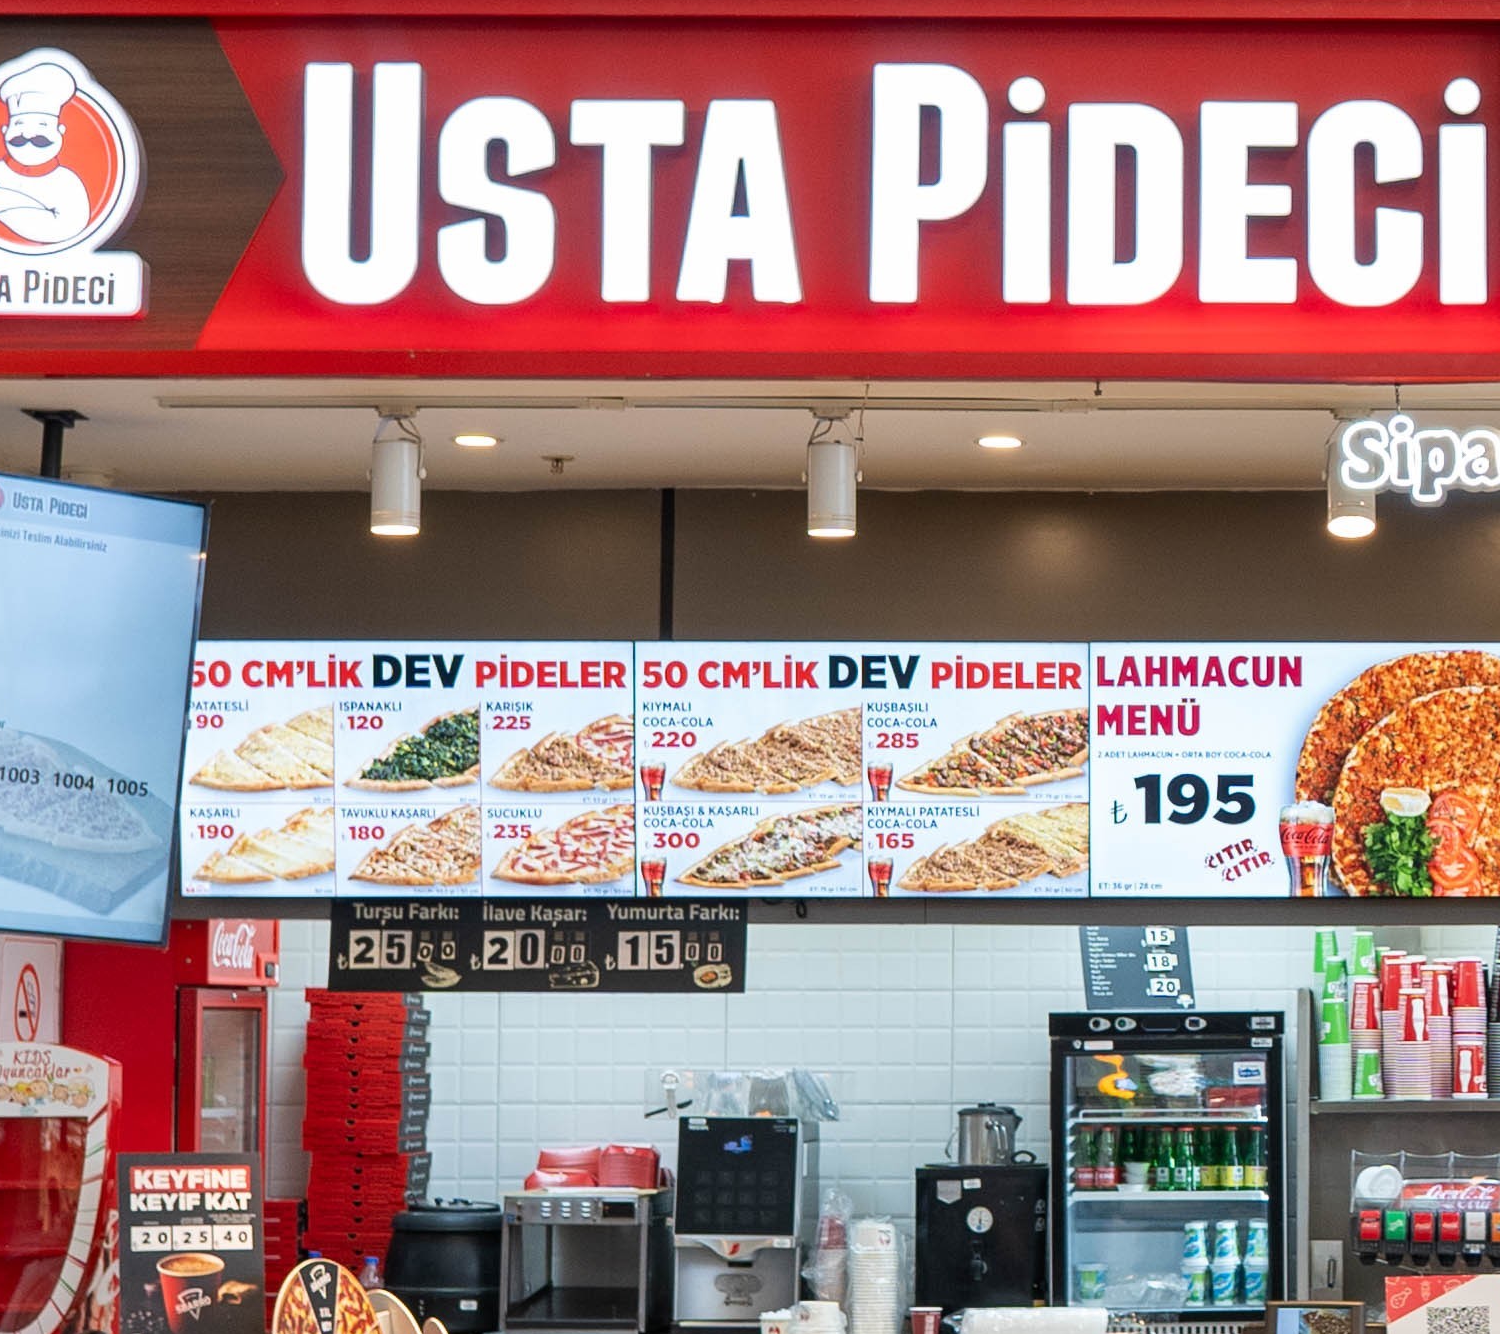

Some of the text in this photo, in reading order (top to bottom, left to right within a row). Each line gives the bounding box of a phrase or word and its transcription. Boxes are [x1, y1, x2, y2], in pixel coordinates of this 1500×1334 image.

[302, 61, 801, 307] USTA
[13, 491, 44, 515] USTA
[53, 533, 107, 553] Alabilirsiniz
[192, 660, 231, 688] 50
[373, 654, 464, 688] DEV
[476, 654, 626, 688] PİDELER
[642, 660, 688, 689] 50
[829, 655, 920, 689] DEV
[931, 654, 1082, 689] PİDELER
[1097, 655, 1303, 688] LAHMACUN
[339, 701, 402, 712] ISPANAKLI
[643, 701, 692, 712] KIYMALI
[196, 715, 223, 729] 90
[348, 715, 383, 730] 120
[492, 715, 531, 731] 225
[643, 717, 714, 728] COCA-COLA
[867, 717, 938, 728] COCA-COLA
[1097, 697, 1200, 736] MENÜ
[651, 732, 697, 749] 220
[876, 733, 919, 749] 285
[1223, 751, 1272, 759] COCA-COLA
[53, 772, 94, 792] 1004
[107, 777, 148, 798] 1005
[341, 807, 389, 819] TAVUKLU
[487, 807, 542, 819] SUCUKLU
[867, 805, 980, 817] KIYMALI PATATESLİ
[644, 817, 714, 829] COCA-COLA
[867, 818, 938, 829] COCA-COLA
[197, 824, 234, 840] 190
[349, 825, 385, 840] 180
[493, 824, 532, 840] 235
[653, 833, 701, 849] 300
[876, 833, 915, 849] 165
[354, 904, 460, 926] Turşu Farkı:
[483, 904, 587, 927] İlave Kaşar:
[606, 904, 740, 921] Yumurta Farkı:
[12, 1050, 52, 1065] KIDS
[133, 1167, 247, 1190] KEYFİNE
[130, 1192, 252, 1212] KEYİF KAT
